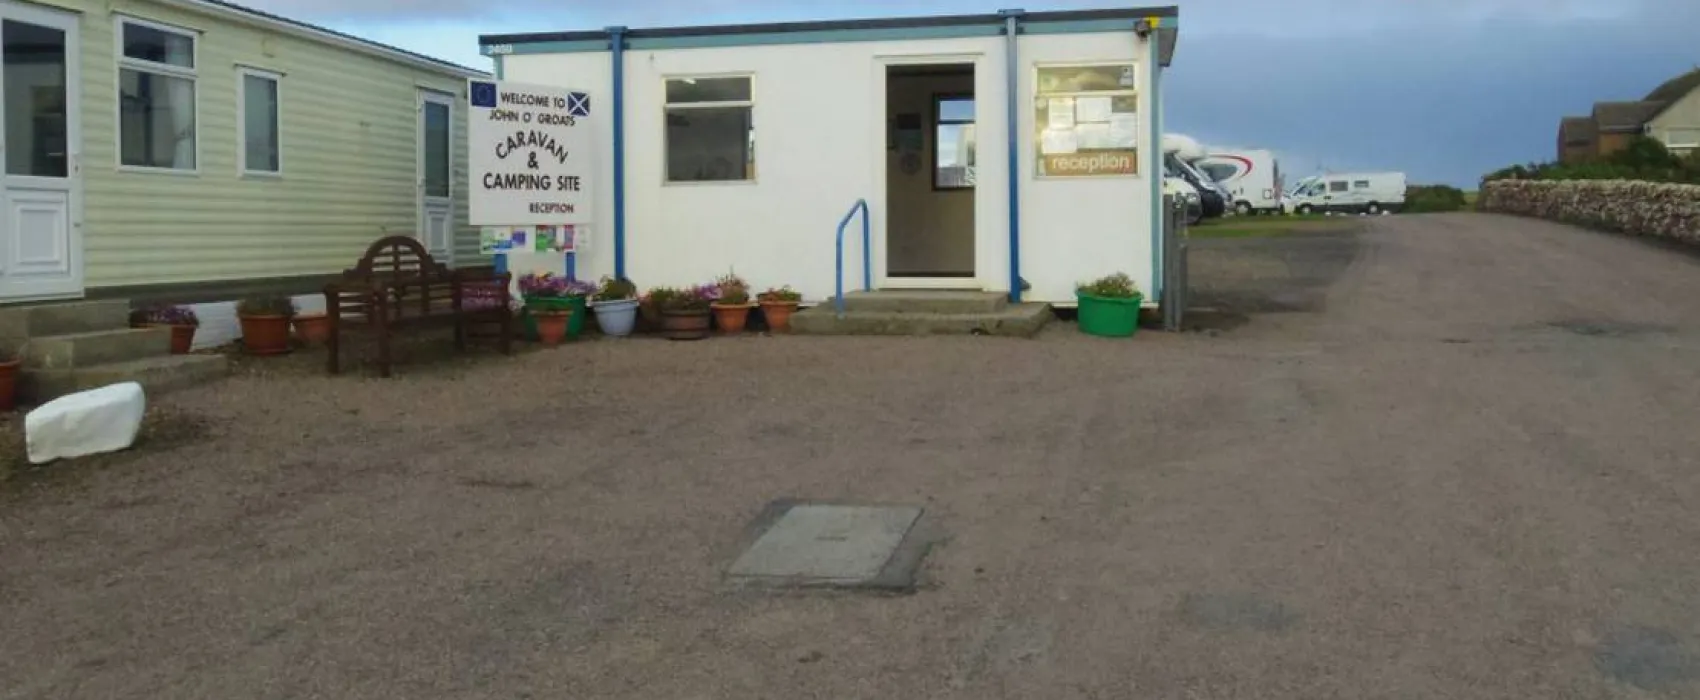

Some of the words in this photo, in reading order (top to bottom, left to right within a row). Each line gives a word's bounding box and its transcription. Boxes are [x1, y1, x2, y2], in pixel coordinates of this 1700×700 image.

[501, 92, 549, 108] WELCOME
[553, 97, 565, 109] TO
[489, 109, 519, 121] JOHN
[538, 115, 575, 127] GROATS
[495, 129, 569, 164] CARAVAN
[527, 151, 539, 169] &
[1053, 153, 1130, 173] reception
[483, 172, 552, 191] CAMPING
[557, 176, 581, 192] SITE
[529, 202, 574, 214] RECEPTION
